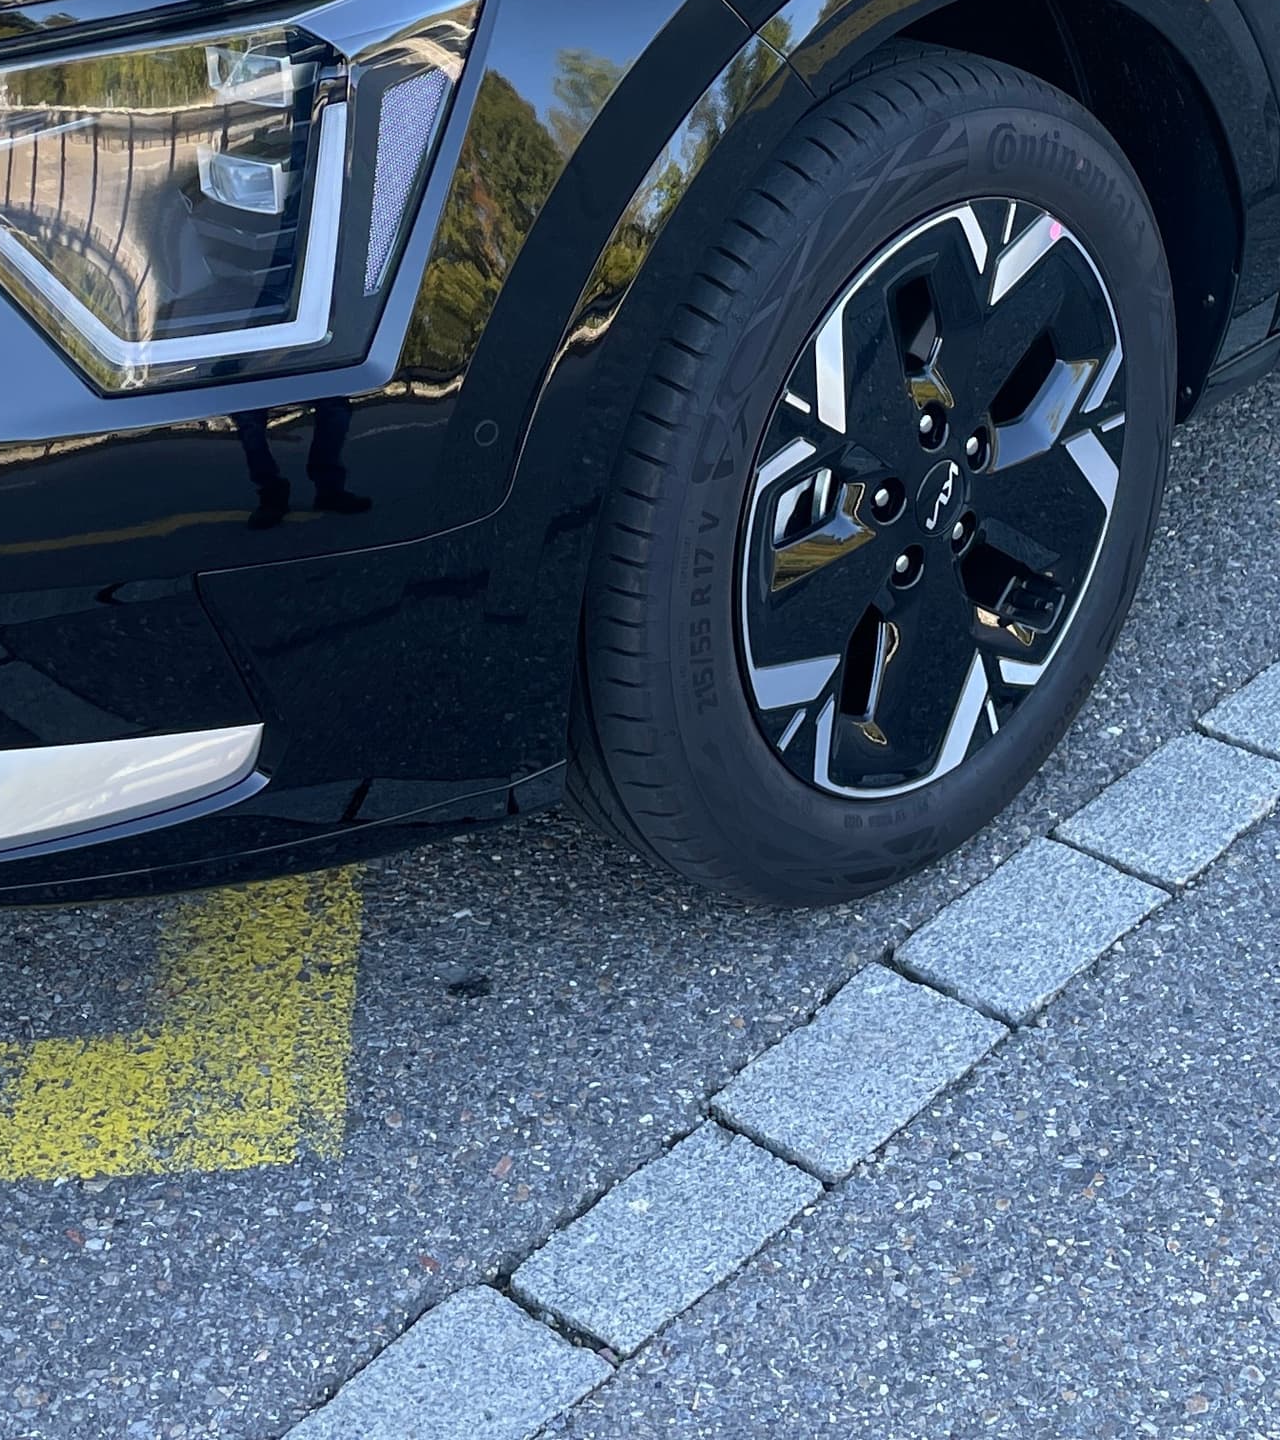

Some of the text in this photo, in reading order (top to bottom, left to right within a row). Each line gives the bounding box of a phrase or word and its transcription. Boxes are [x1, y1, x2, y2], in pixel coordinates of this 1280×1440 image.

[693, 547, 715, 579] 17
[690, 583, 713, 608] R
[689, 617, 720, 716] 215/55
